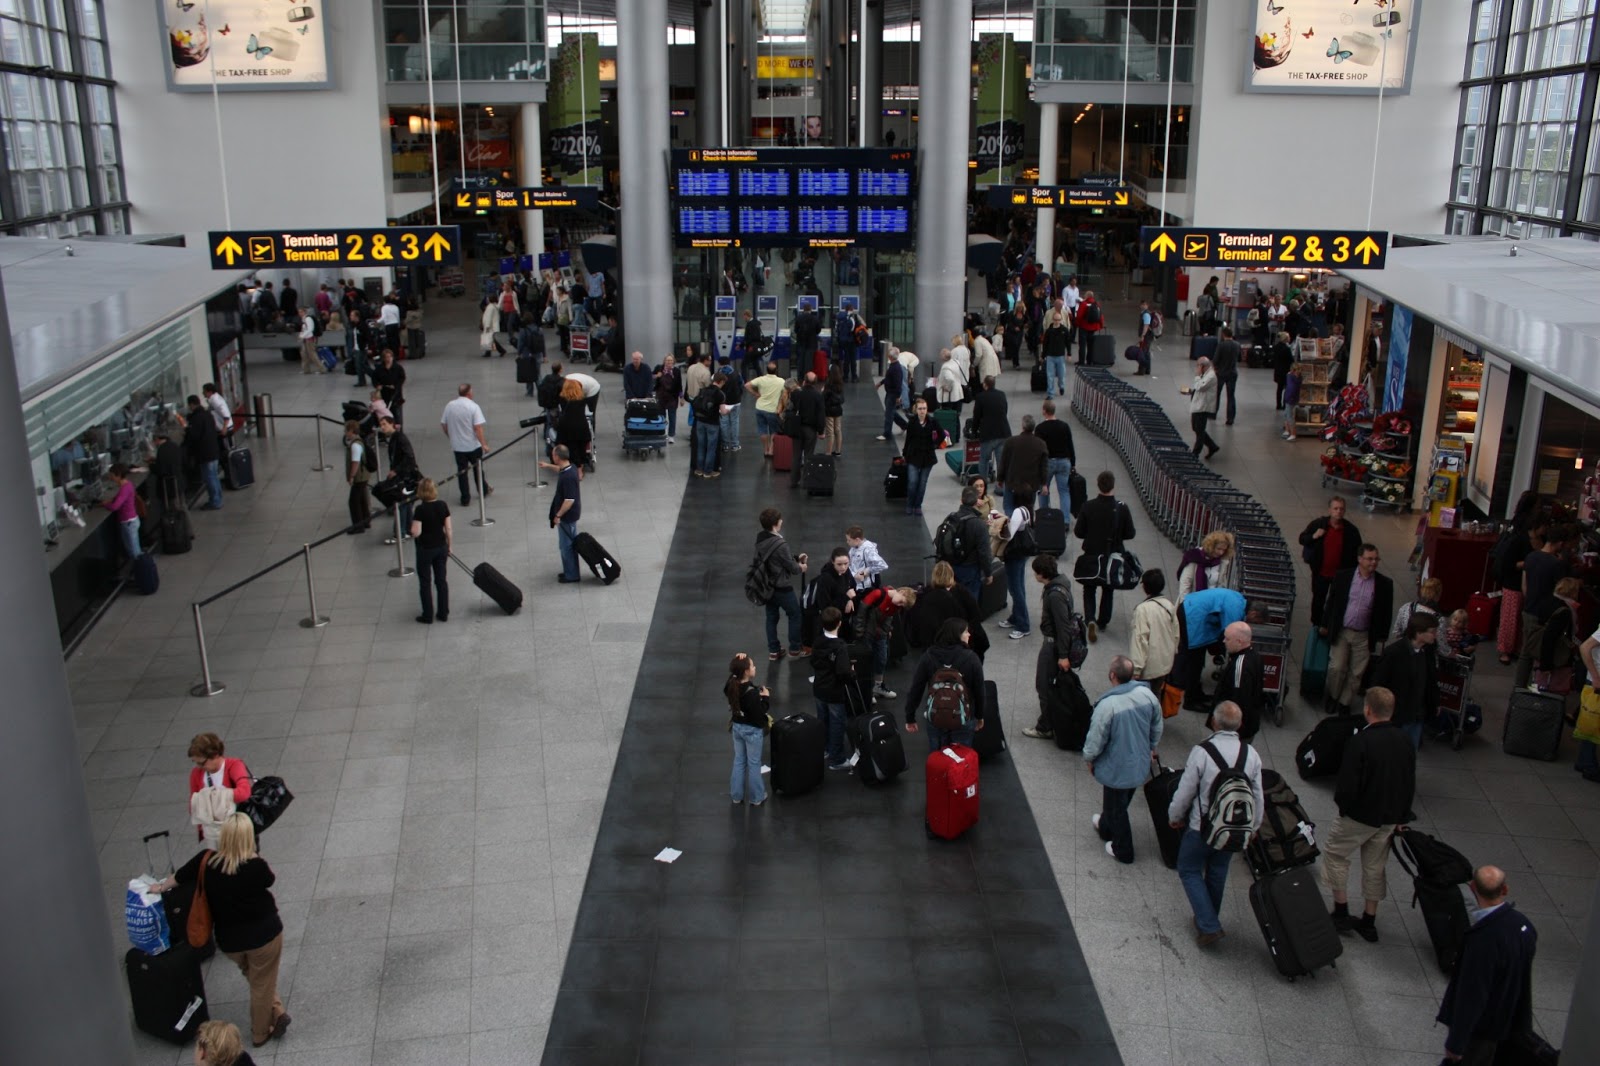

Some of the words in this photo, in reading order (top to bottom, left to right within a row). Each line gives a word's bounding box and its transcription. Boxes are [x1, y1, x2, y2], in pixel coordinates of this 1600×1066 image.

[790, 60, 801, 68] WE
[270, 68, 292, 76] SHOP
[1305, 72, 1344, 80] TAX-FREE
[567, 136, 601, 155] 20%
[978, 136, 1011, 155] 20%
[496, 190, 514, 198] Spor
[522, 191, 530, 206] 1
[1032, 188, 1050, 196] Spor
[1058, 190, 1065, 204] 1
[496, 198, 518, 206] Track
[1032, 196, 1053, 204] Track
[282, 234, 339, 247] Terminal
[735, 239, 740, 247] 3
[1218, 233, 1273, 246] Terminal
[346, 235, 364, 260] 2
[371, 234, 394, 260] &
[400, 233, 419, 260] 3
[1279, 236, 1297, 261] 2
[1303, 235, 1323, 262] &
[1332, 236, 1350, 262] 3
[284, 248, 339, 262] Terminal
[1217, 247, 1272, 261] Terminal
